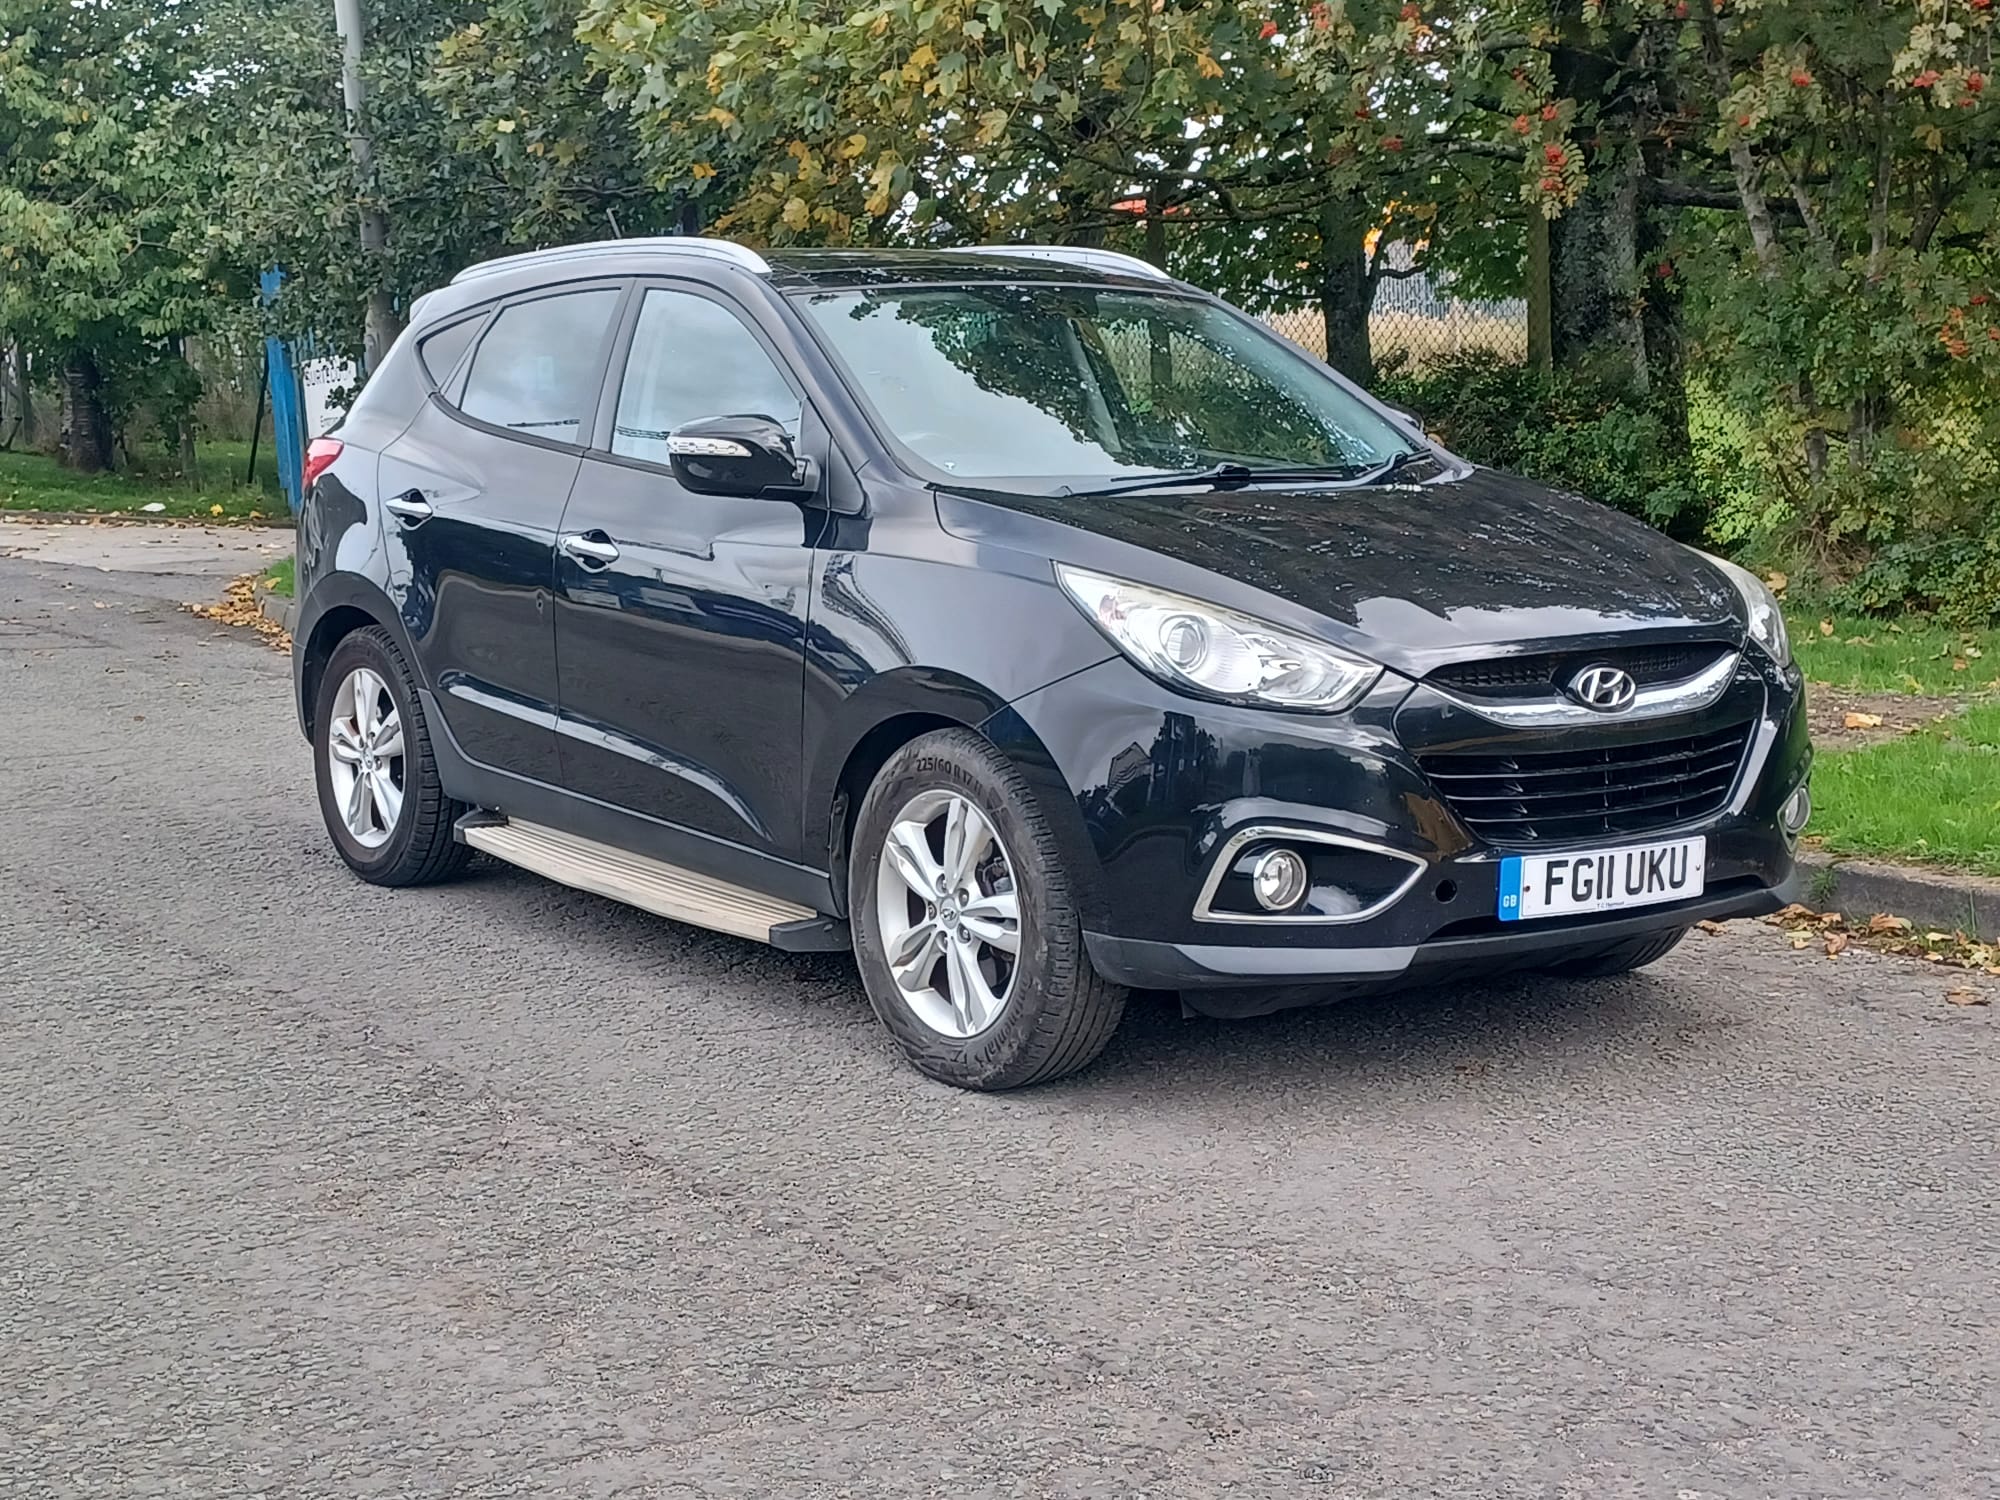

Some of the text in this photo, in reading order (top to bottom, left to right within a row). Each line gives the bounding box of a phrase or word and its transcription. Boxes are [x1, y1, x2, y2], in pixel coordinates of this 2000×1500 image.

[916, 757, 952, 775] 225/60
[963, 769, 973, 786] 17
[1544, 844, 1688, 906] FG11 UKU
[1502, 894, 1517, 908] GB
